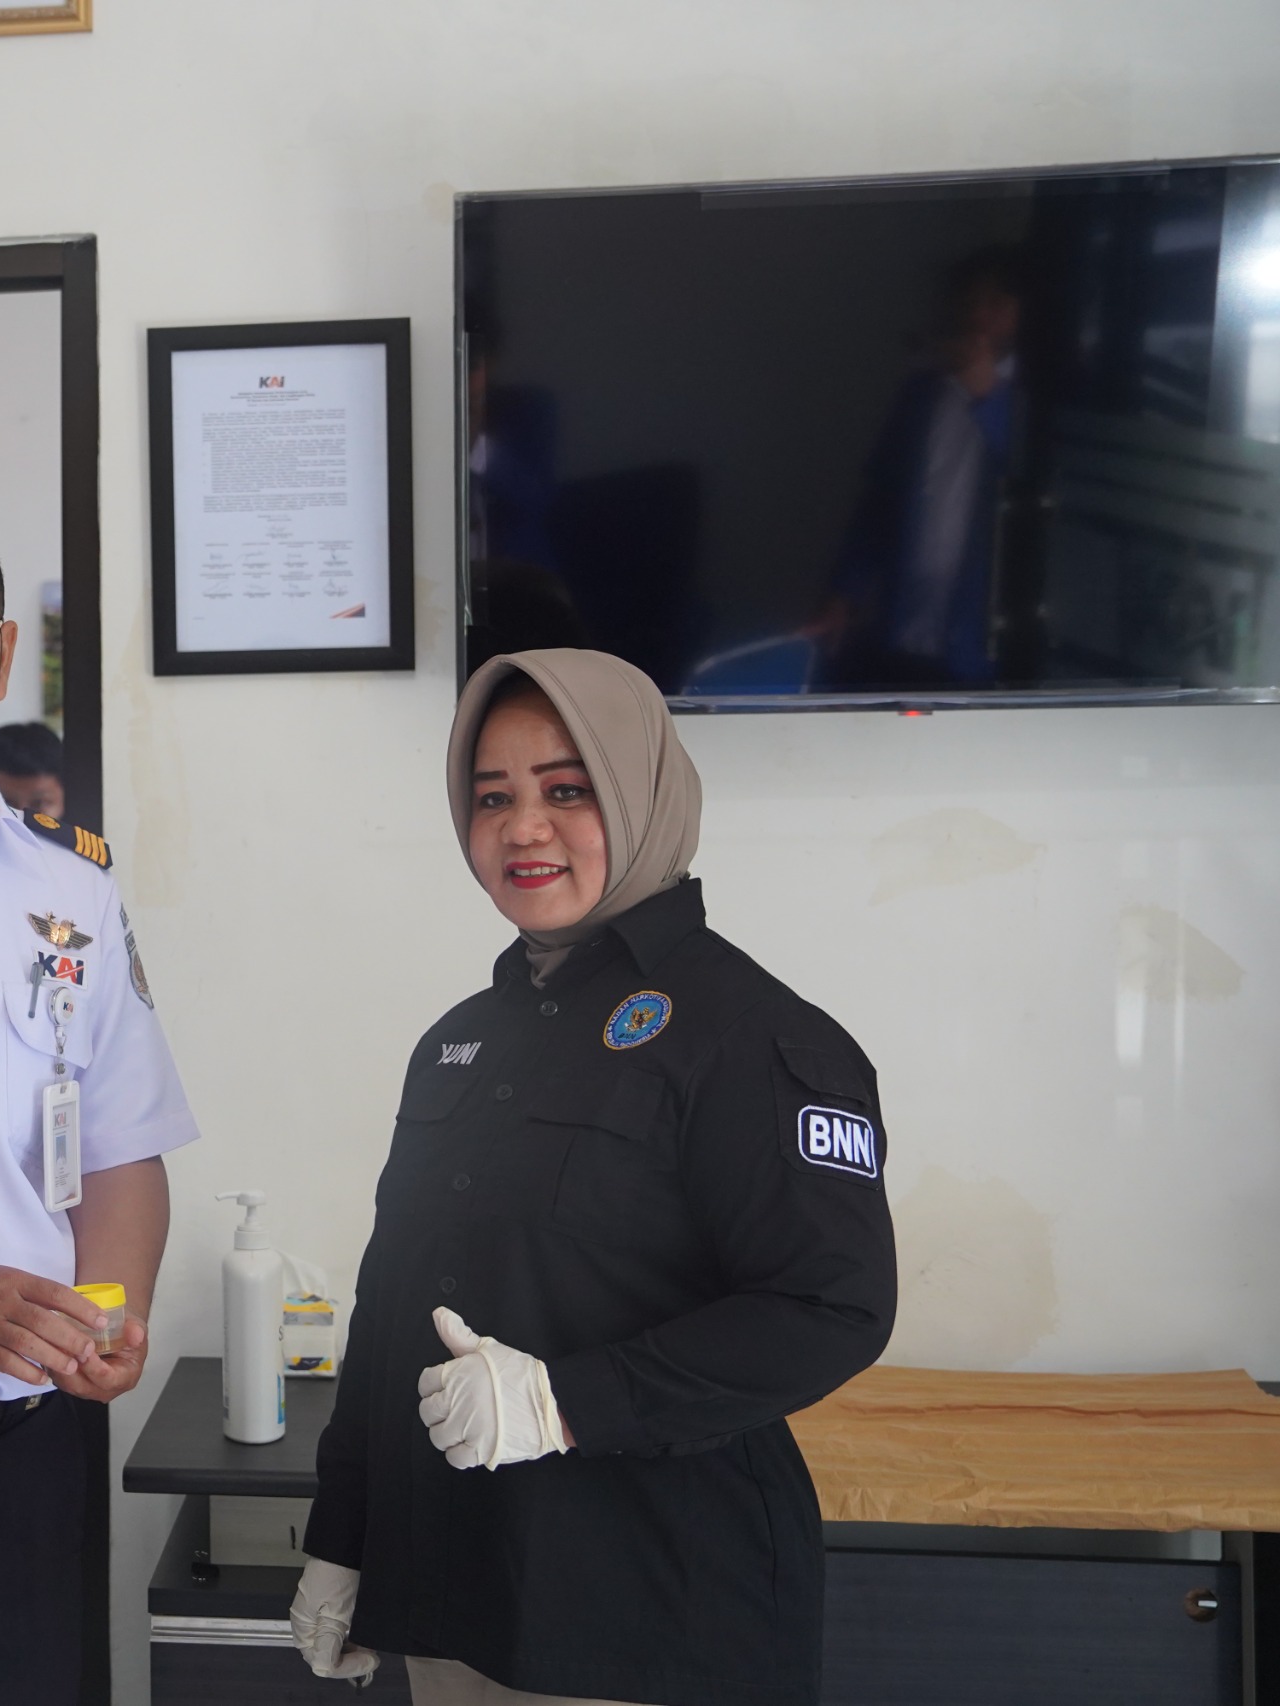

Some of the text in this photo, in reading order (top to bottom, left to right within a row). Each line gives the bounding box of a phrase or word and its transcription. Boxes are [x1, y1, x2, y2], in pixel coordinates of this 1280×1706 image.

[258, 376, 285, 389] KAI
[37, 951, 84, 986] KAI
[435, 1041, 482, 1066] YUNI
[809, 1114, 872, 1169] BNN
